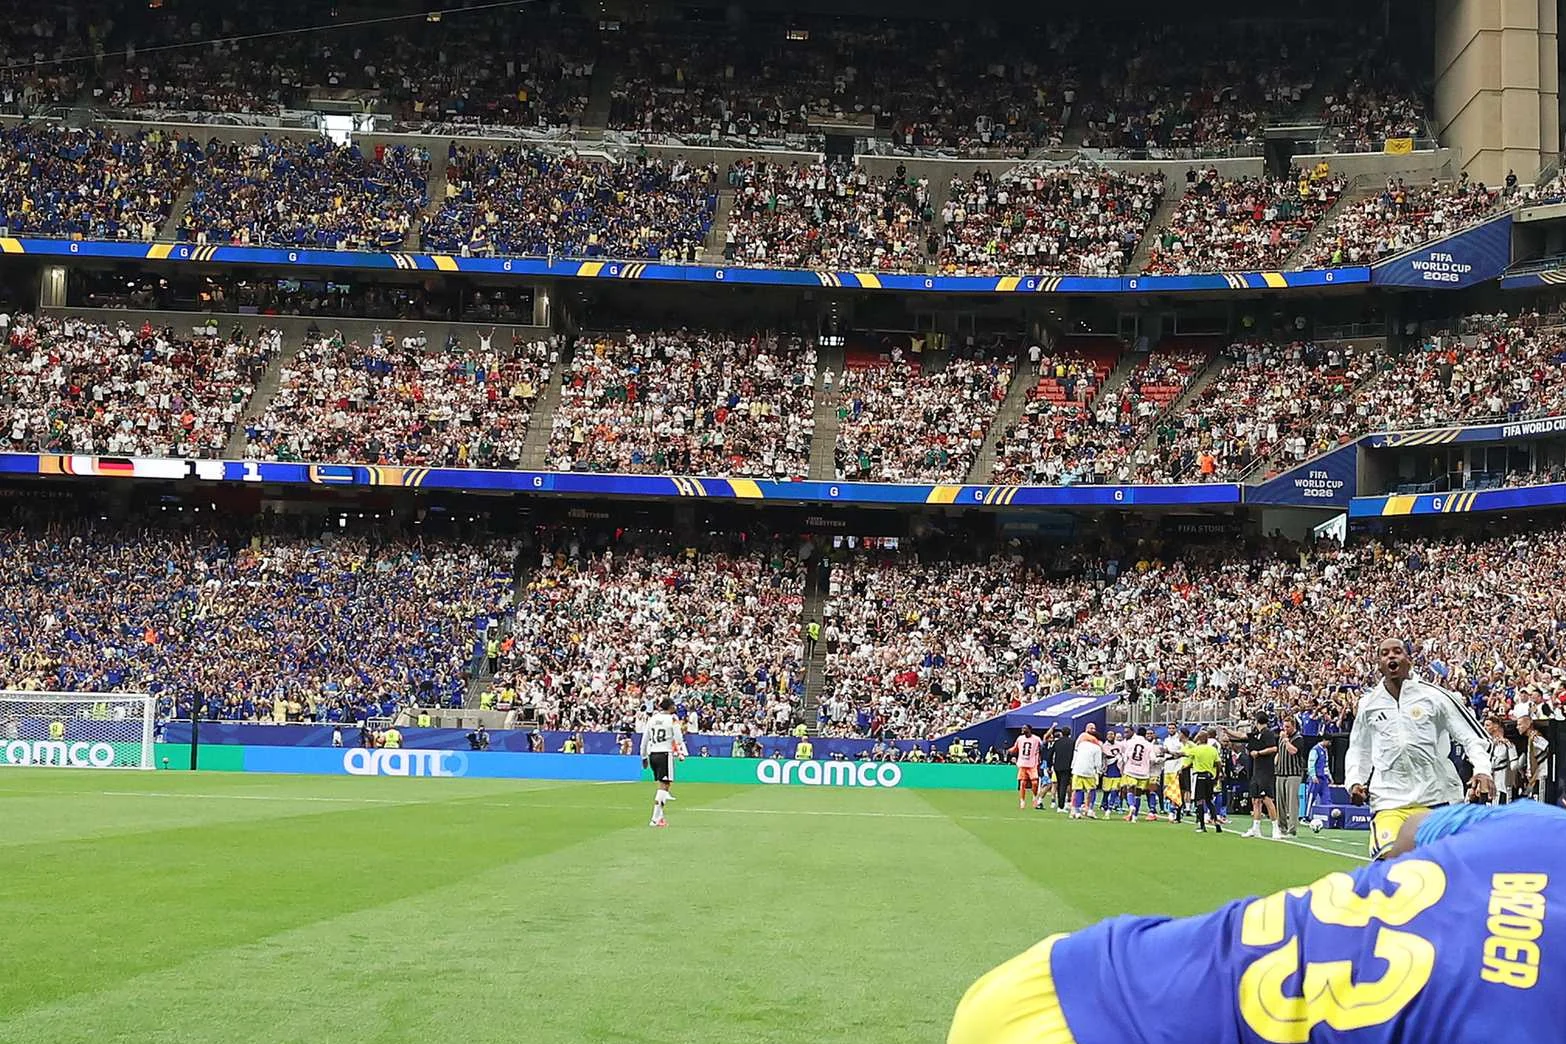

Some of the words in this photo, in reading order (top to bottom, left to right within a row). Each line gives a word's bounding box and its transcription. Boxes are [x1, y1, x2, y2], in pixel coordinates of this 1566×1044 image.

[1430, 252, 1453, 262] FIFA
[1412, 261, 1450, 271] WORLD
[1451, 263, 1472, 273] CUP
[1423, 271, 1460, 282] 2026
[1503, 426, 1521, 437] FIFA
[1522, 420, 1553, 434] WORLD
[1309, 470, 1328, 479] FIFA
[1295, 479, 1325, 488] WORLD
[1326, 480, 1344, 489] CUP
[1303, 489, 1334, 497] 2026
[756, 759, 901, 787] aramco
[1479, 871, 1549, 990] BAZOER
